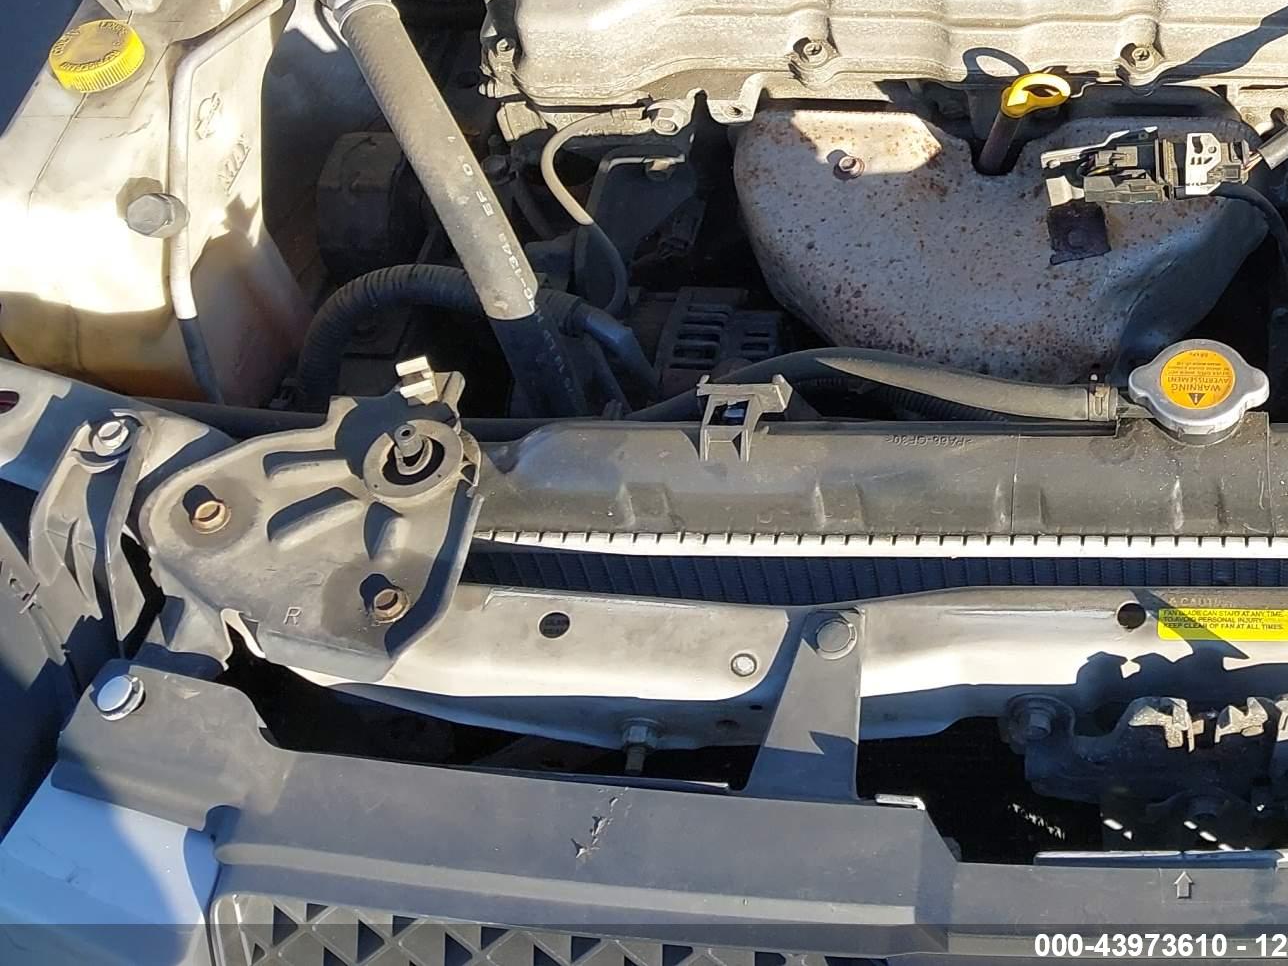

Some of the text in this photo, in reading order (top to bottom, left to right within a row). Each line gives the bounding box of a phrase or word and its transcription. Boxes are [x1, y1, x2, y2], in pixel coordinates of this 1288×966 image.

[1171, 383, 1221, 392] WARNING
[283, 606, 302, 625] R
[1198, 616, 1237, 624] PERSONAL
